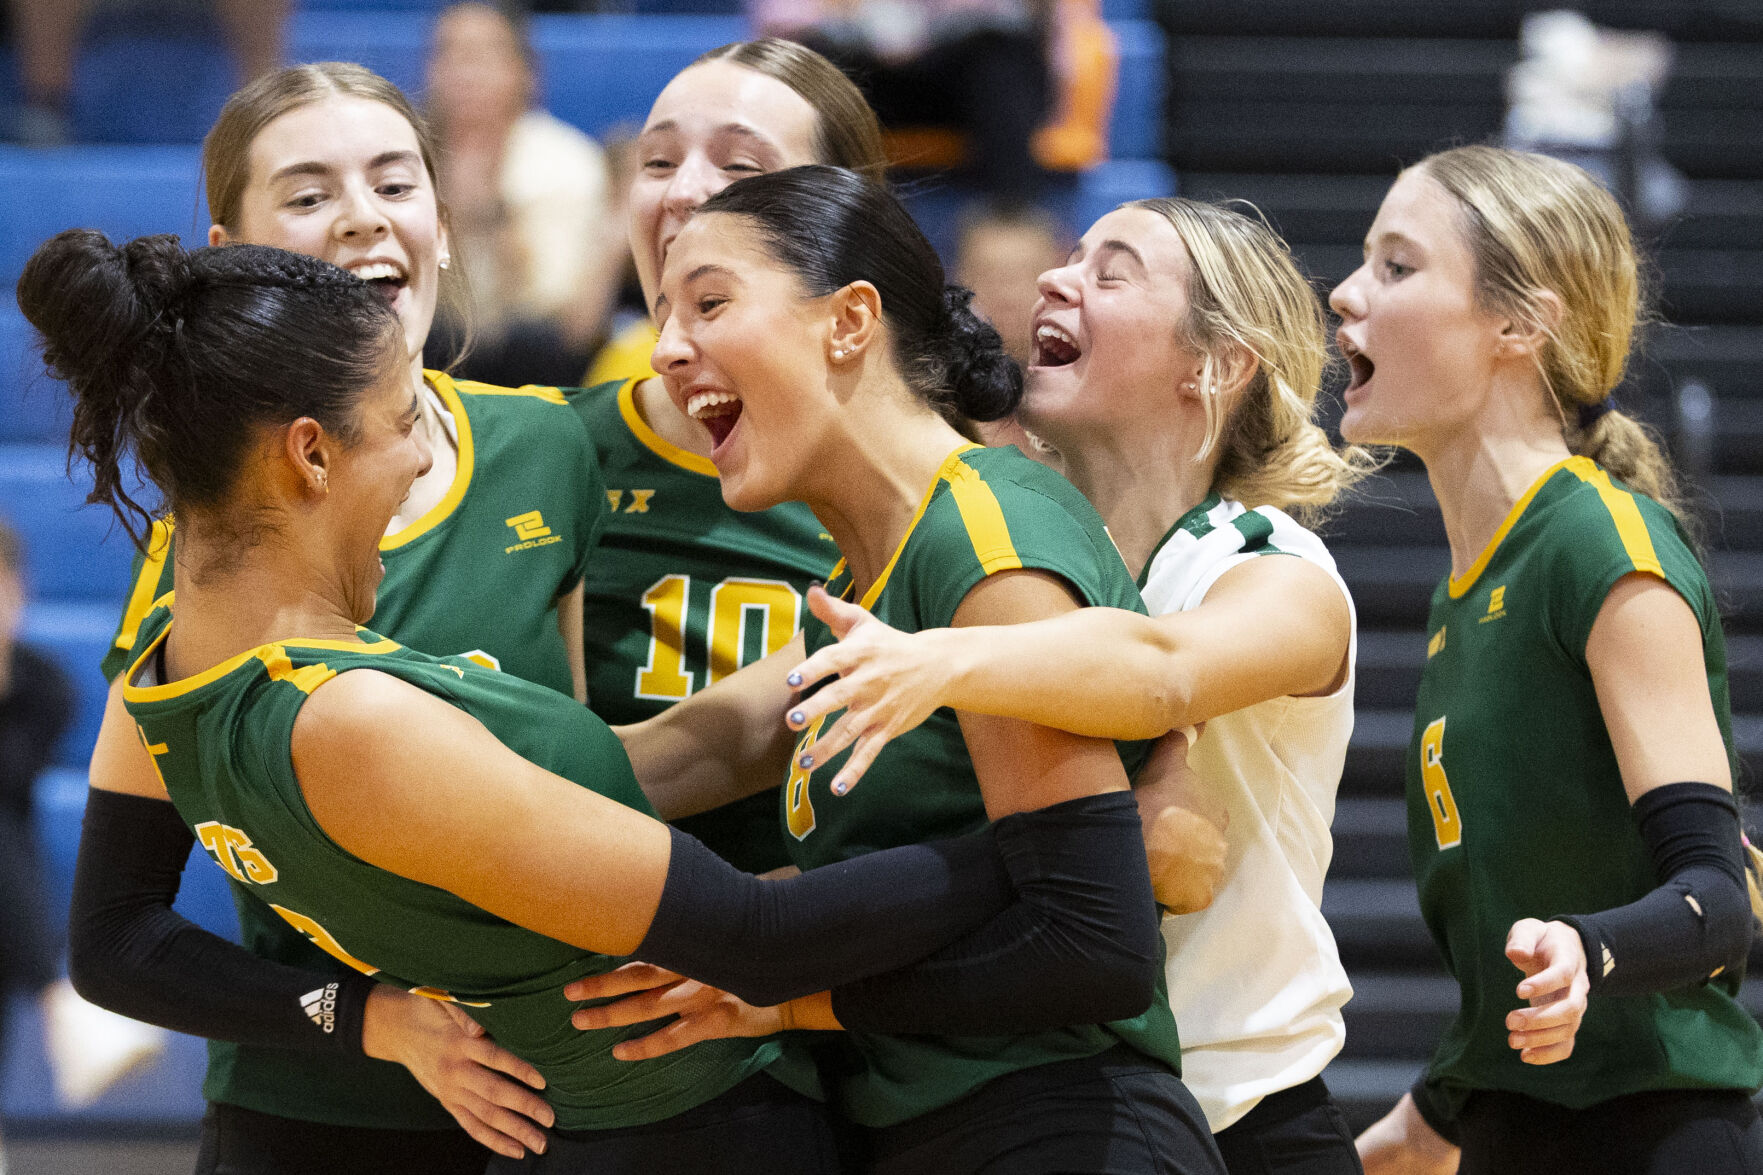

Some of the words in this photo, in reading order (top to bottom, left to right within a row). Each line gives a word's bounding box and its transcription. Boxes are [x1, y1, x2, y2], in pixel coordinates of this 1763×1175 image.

[505, 535, 562, 555] PROLOOK
[634, 573, 802, 699] 10
[1421, 715, 1462, 851] 6
[322, 982, 340, 1034] adidas
